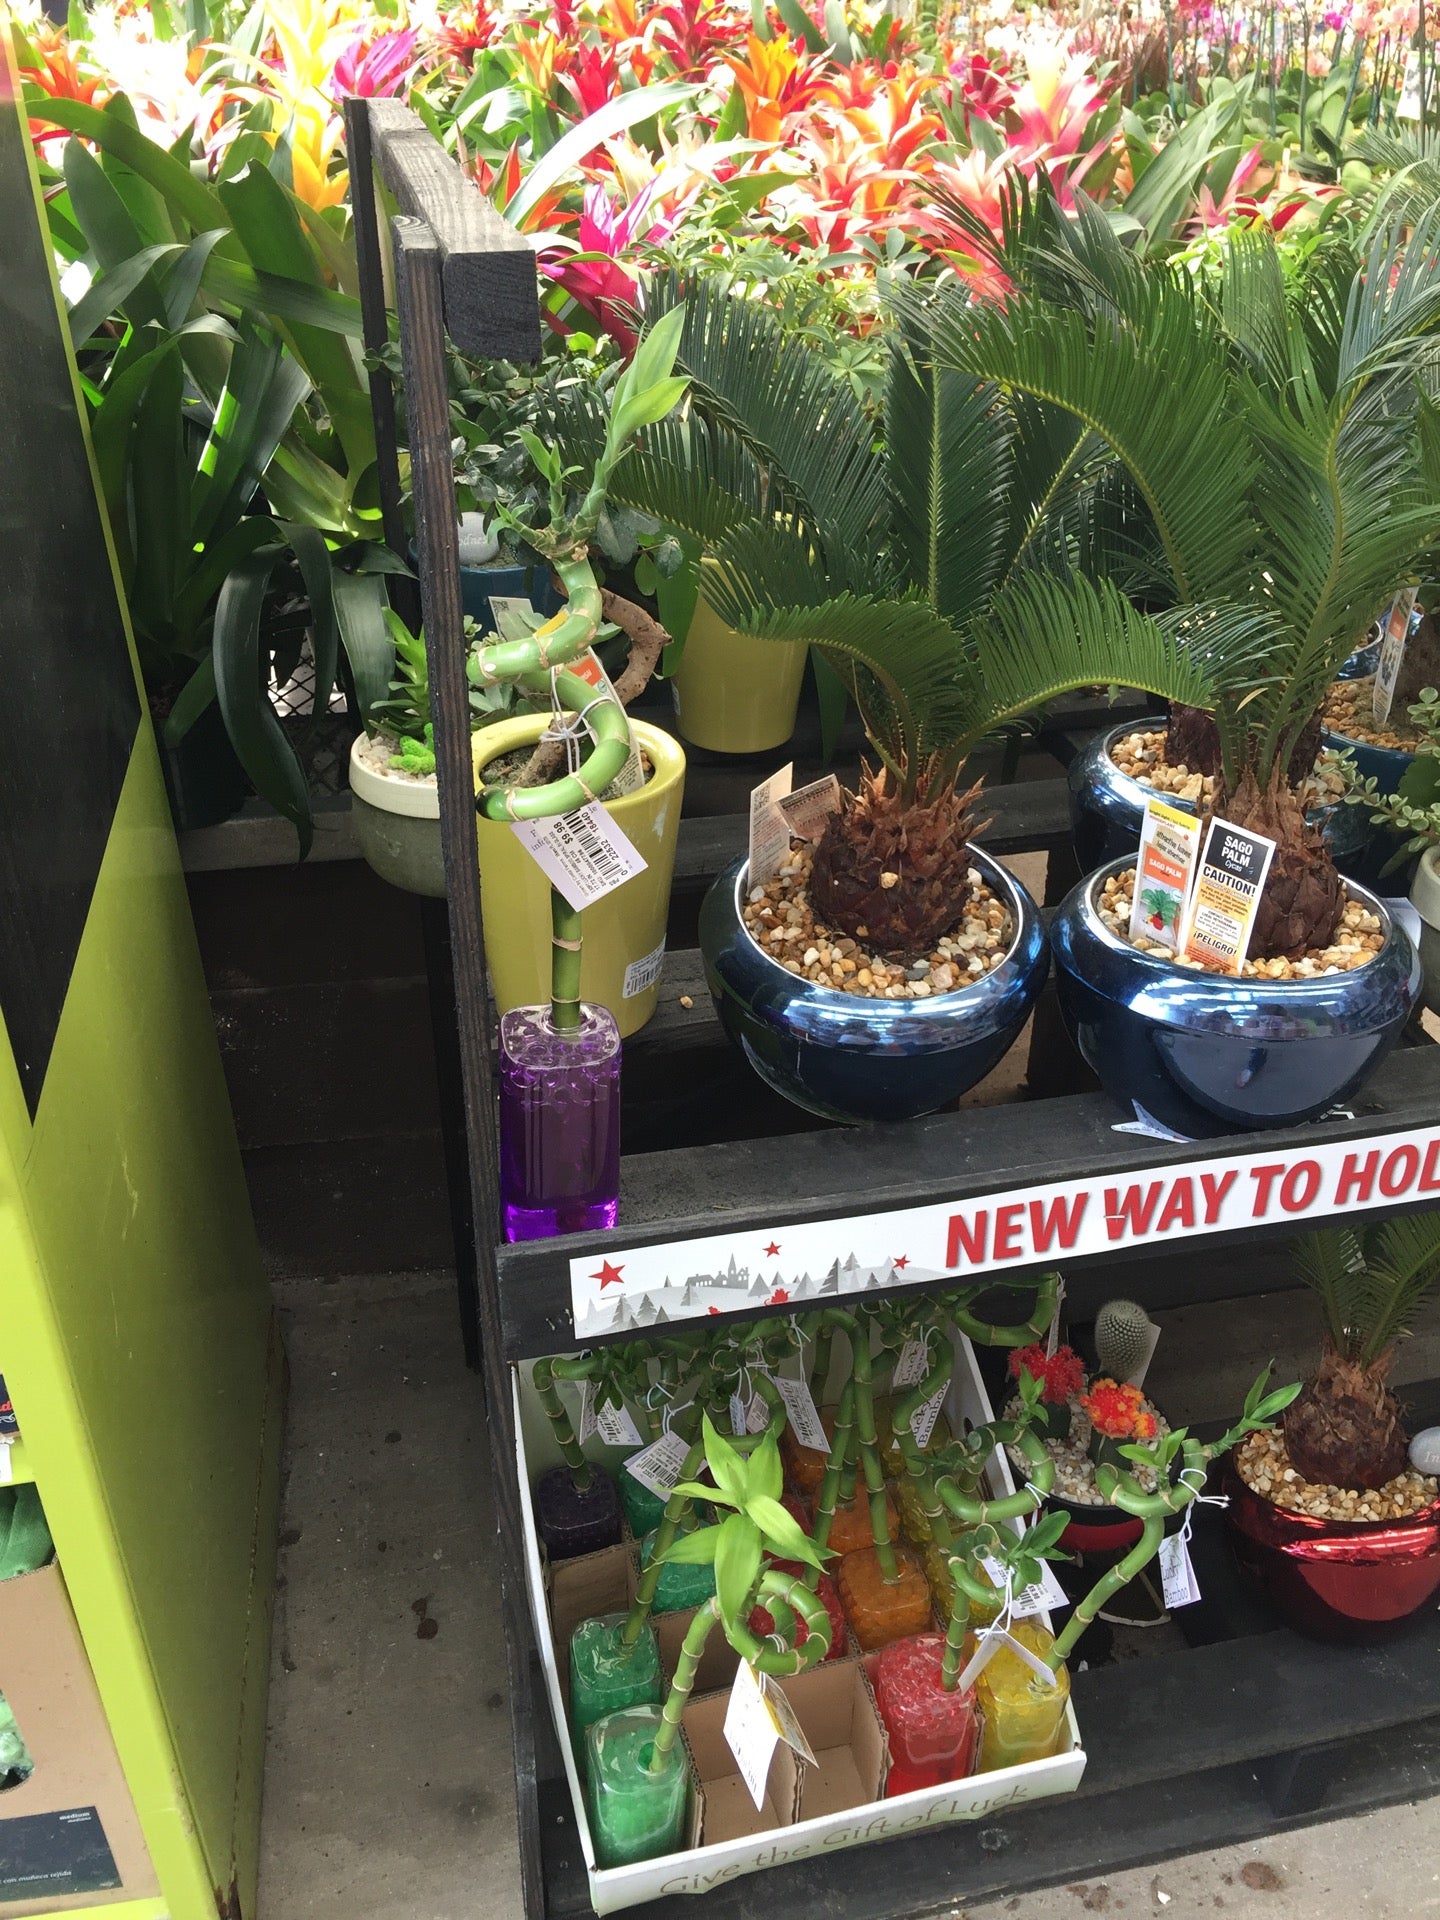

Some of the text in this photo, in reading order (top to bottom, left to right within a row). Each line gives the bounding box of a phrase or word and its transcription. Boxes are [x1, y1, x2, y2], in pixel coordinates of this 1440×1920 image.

[552, 820, 575, 845] $9.98
[580, 811, 600, 833] 18440
[600, 838, 620, 861] 22532
[1224, 835, 1253, 854] SAGO
[1221, 847, 1250, 867] PALM
[1225, 860, 1243, 872] Cycas
[1203, 866, 1256, 897] CAUTION!
[945, 1141, 1440, 1269] NEW WAY TO HOL
[59, 1812, 90, 1821] medium
[659, 1783, 1029, 1895] Give the Gift of Luck
